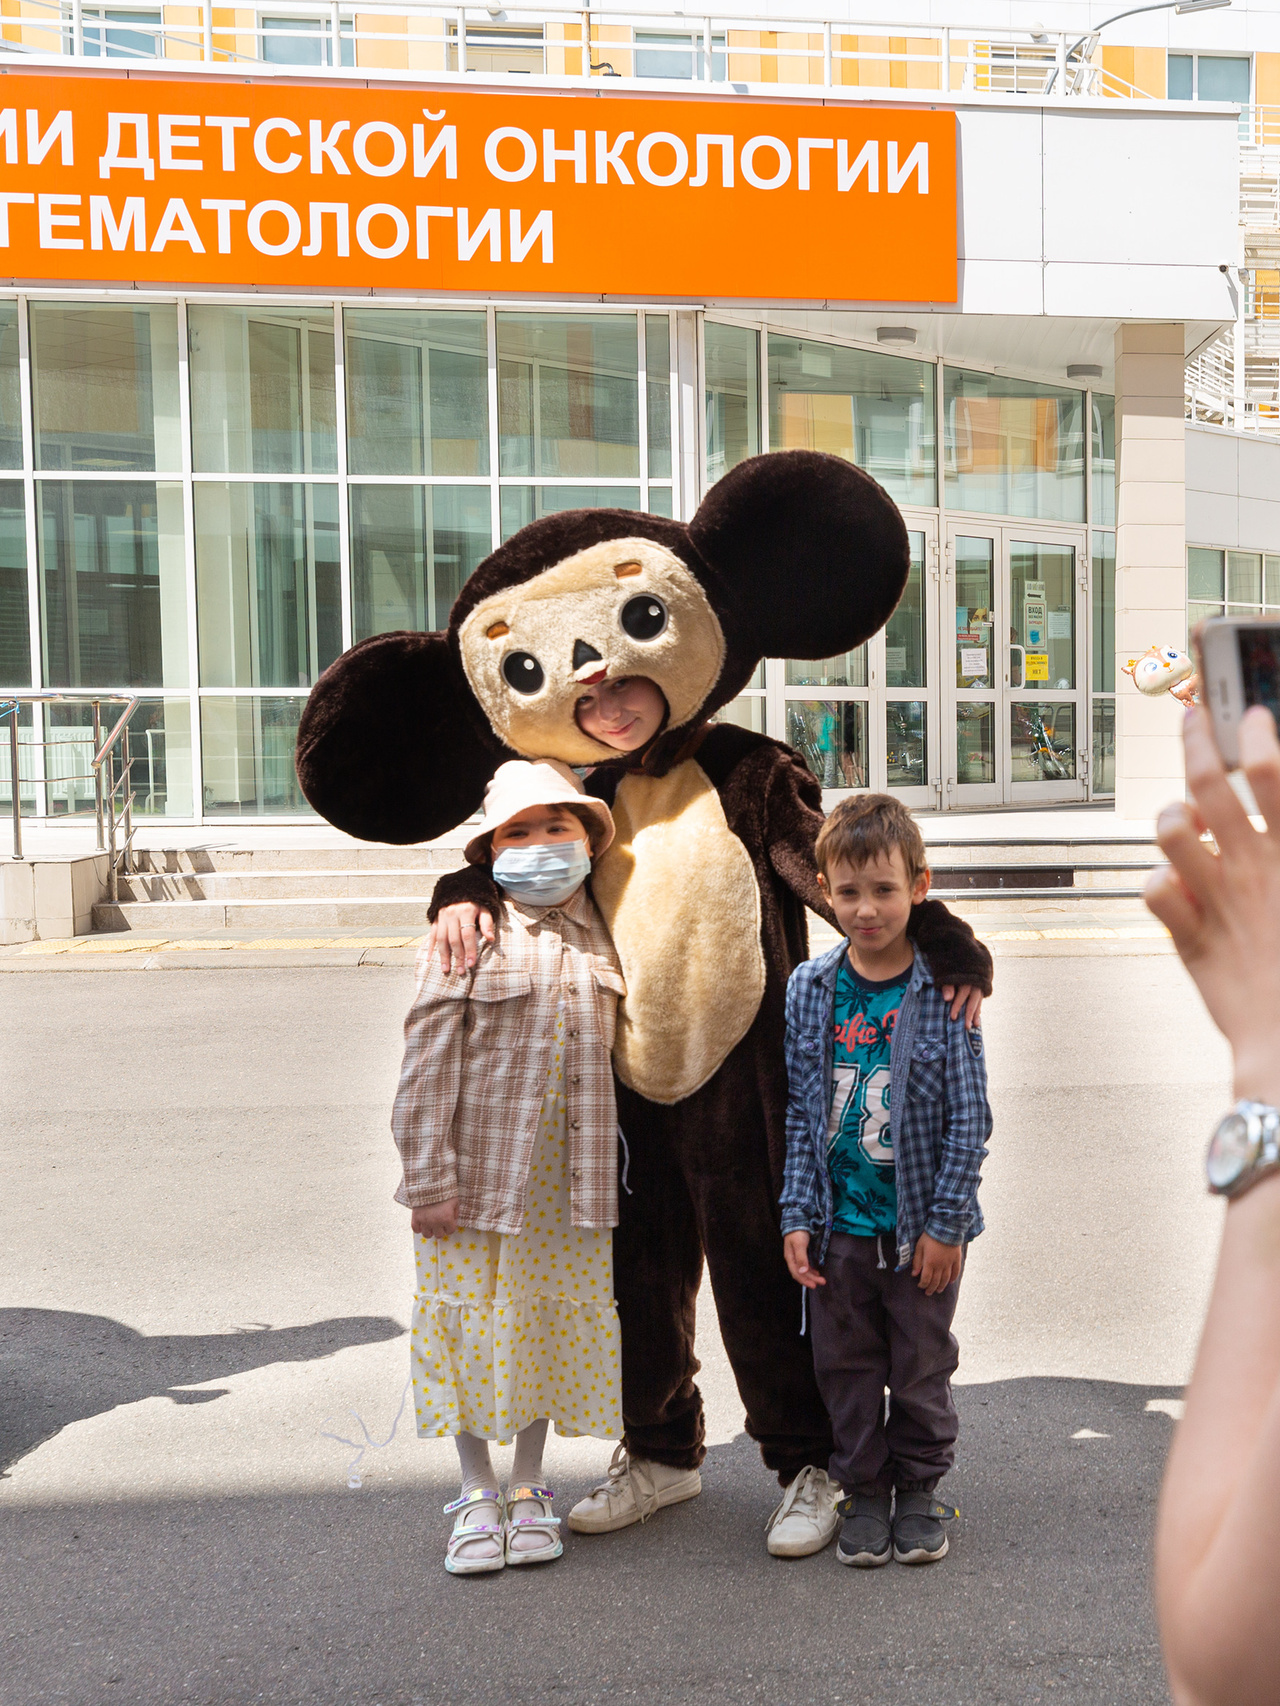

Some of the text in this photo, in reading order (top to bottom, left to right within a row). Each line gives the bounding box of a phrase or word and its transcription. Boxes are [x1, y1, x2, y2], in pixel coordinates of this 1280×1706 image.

[98, 109, 458, 181] ДЕТСКОЙ
[483, 127, 930, 195] ОНКОЛОГИИ
[0, 191, 554, 264] ГЕМАТОЛОГИИ
